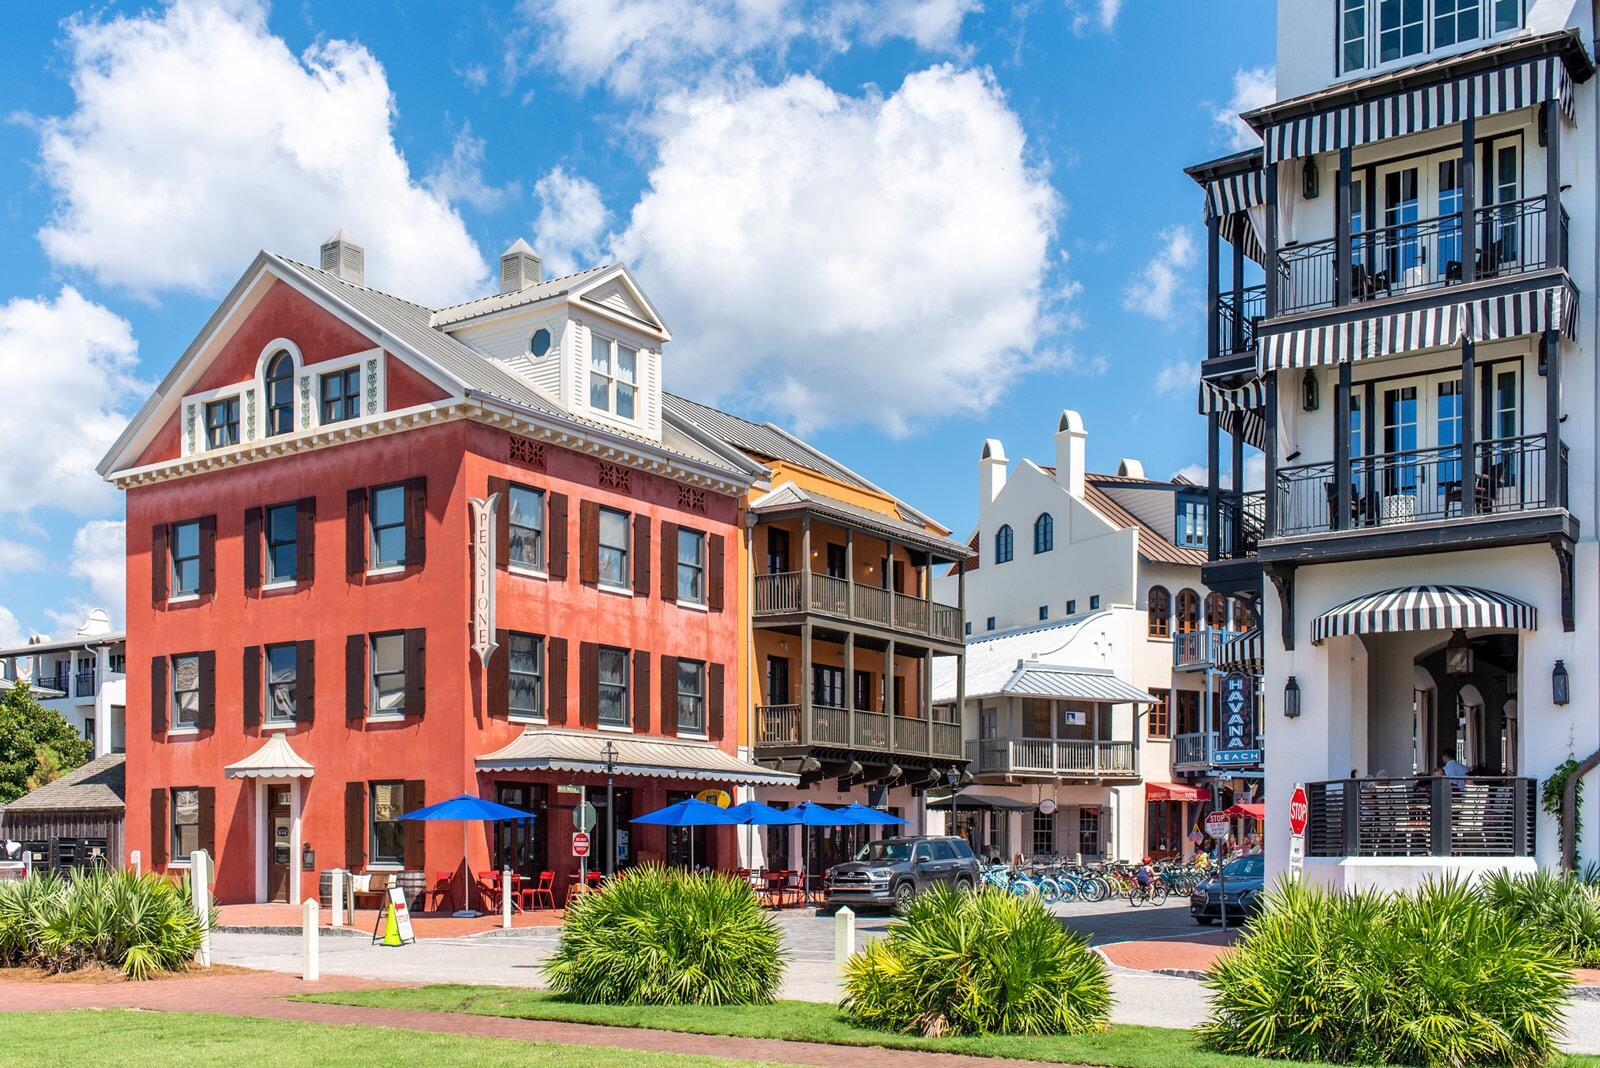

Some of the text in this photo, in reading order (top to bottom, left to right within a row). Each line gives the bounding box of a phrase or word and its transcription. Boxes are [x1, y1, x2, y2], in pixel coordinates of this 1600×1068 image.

[478, 513, 488, 644] PENSIONE
[1228, 680, 1244, 748] HAVANA
[1216, 753, 1258, 761] BEACH
[1210, 814, 1226, 823] STOP
[1291, 802, 1306, 821] STOP
